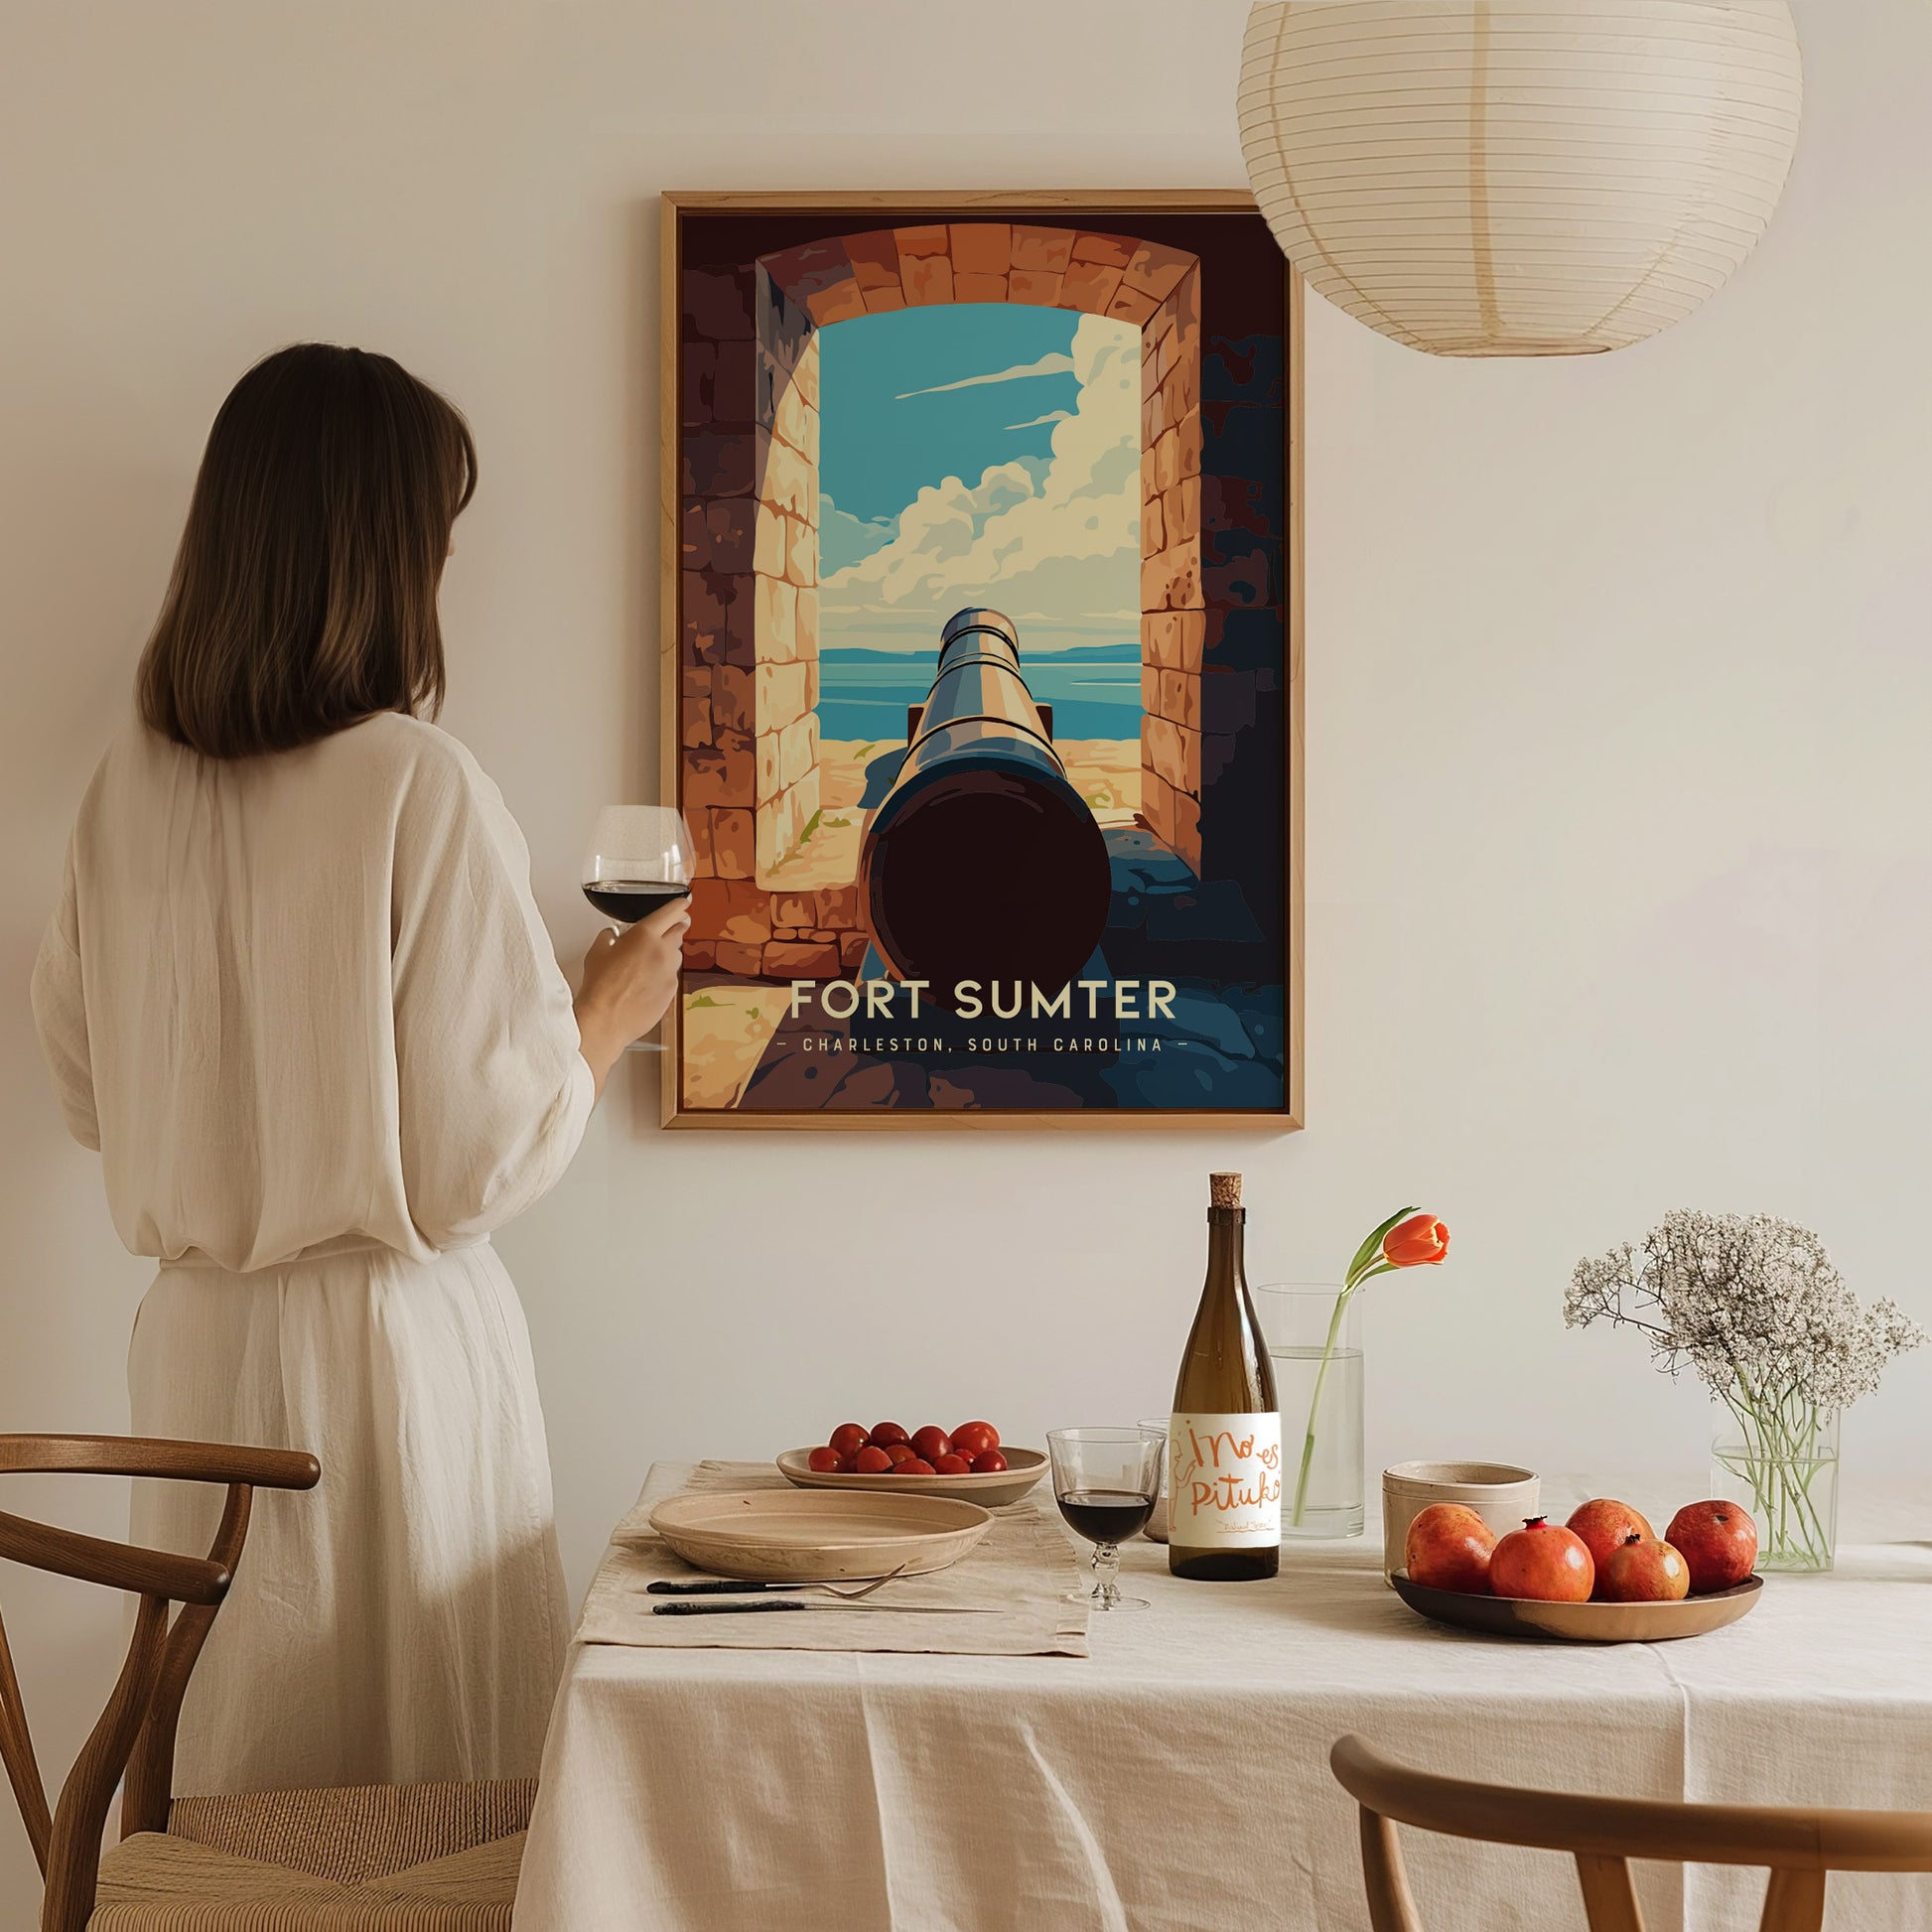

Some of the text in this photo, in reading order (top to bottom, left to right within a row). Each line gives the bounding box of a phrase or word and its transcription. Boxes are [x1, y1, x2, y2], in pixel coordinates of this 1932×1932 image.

[791, 980, 1176, 1020] FORT SUMTER
[802, 1037, 1163, 1052] CHARLESTON, SOUTH CAROLINA
[1256, 1444, 1280, 1470] es
